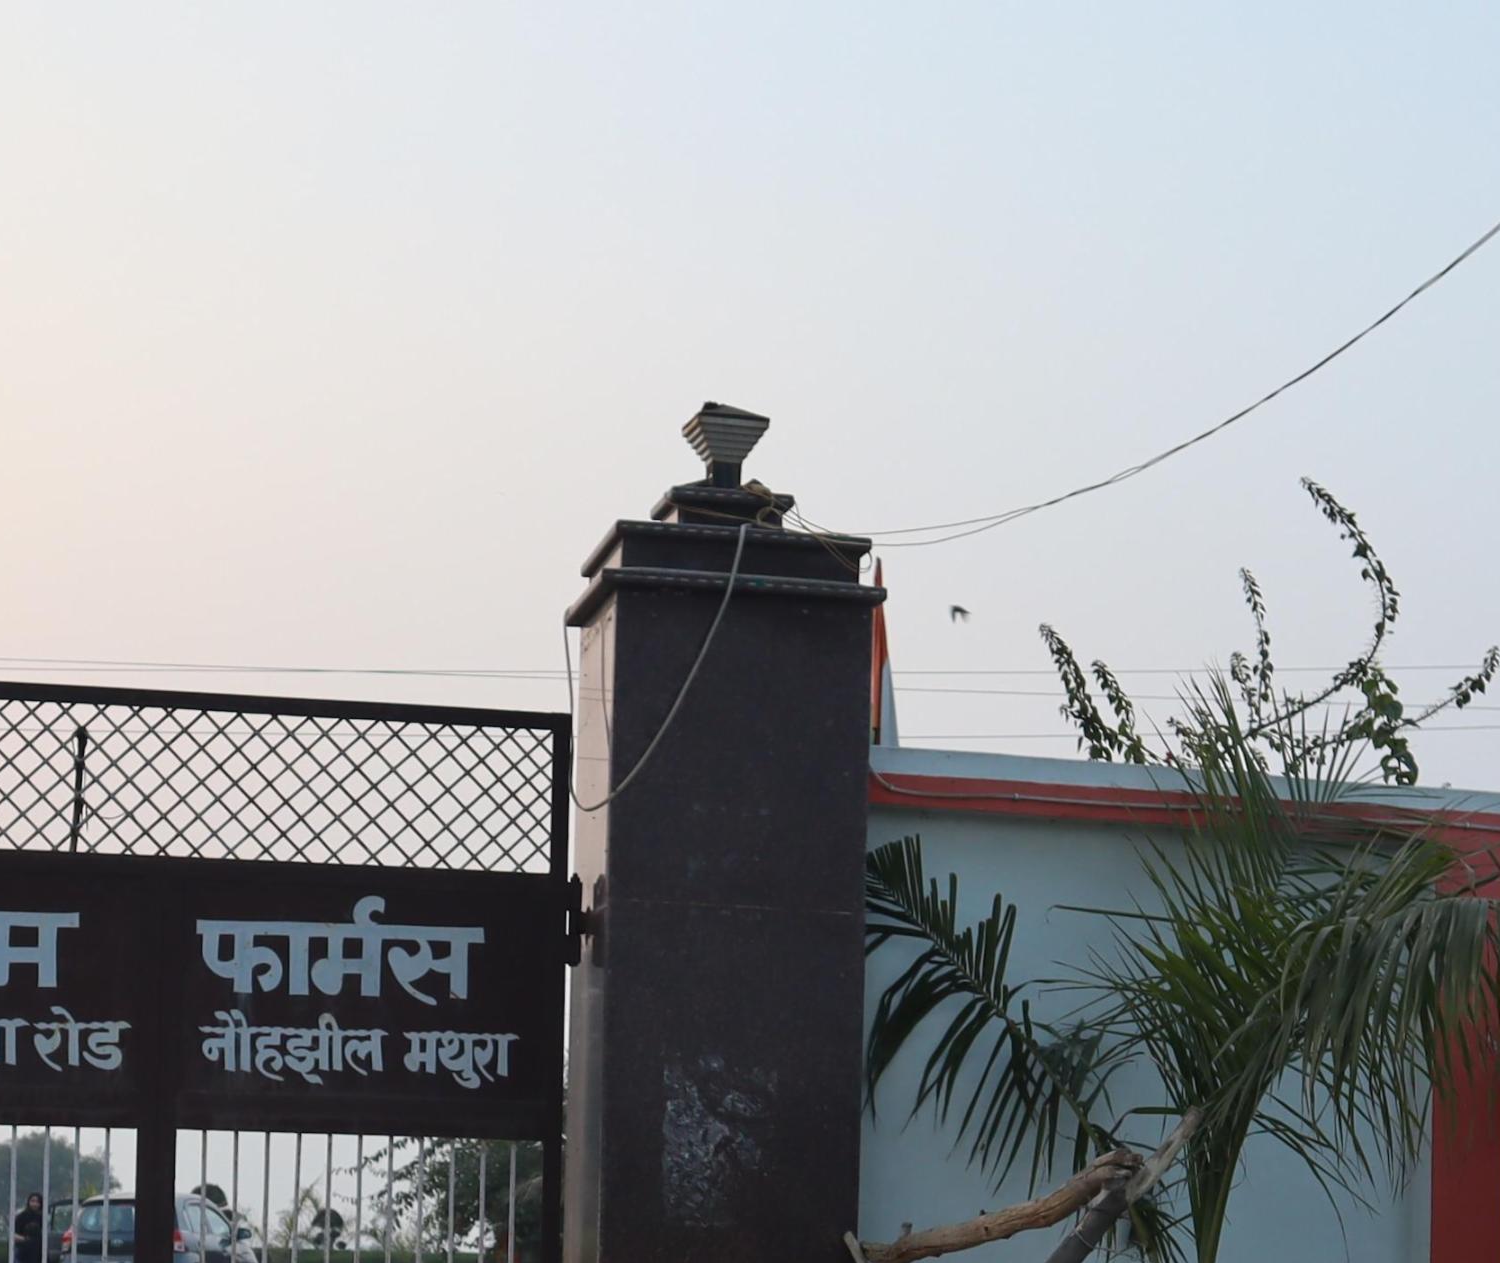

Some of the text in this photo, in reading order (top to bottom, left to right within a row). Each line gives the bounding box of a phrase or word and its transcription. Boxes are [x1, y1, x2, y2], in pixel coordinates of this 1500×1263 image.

[195, 895, 485, 1006] फार्मस
[33, 1005, 132, 1072] रोड
[403, 1030, 520, 1089] मथुरा
